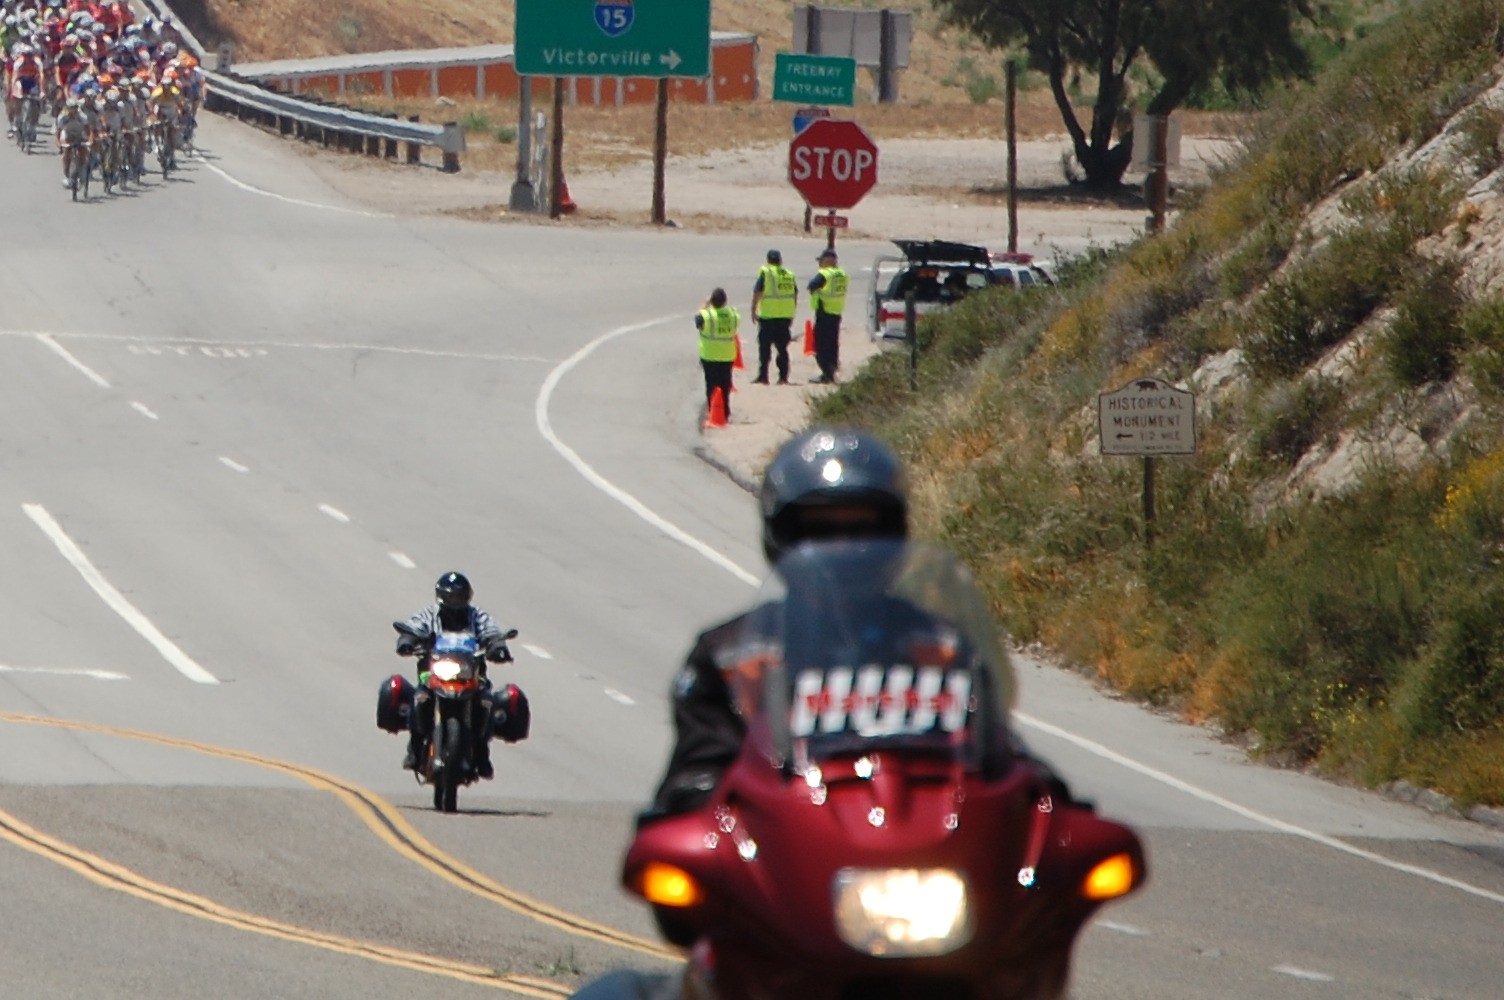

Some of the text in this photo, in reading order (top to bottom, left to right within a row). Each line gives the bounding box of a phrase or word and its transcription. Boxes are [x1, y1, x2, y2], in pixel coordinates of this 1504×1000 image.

[602, 8, 627, 29] 15
[543, 49, 653, 66] Victorville
[786, 63, 843, 79] FREEWAY
[782, 81, 845, 98] ENTRANCE
[794, 146, 874, 182] STOP
[1108, 396, 1185, 411] HISTORICAL
[1113, 415, 1181, 428] MONUMENT
